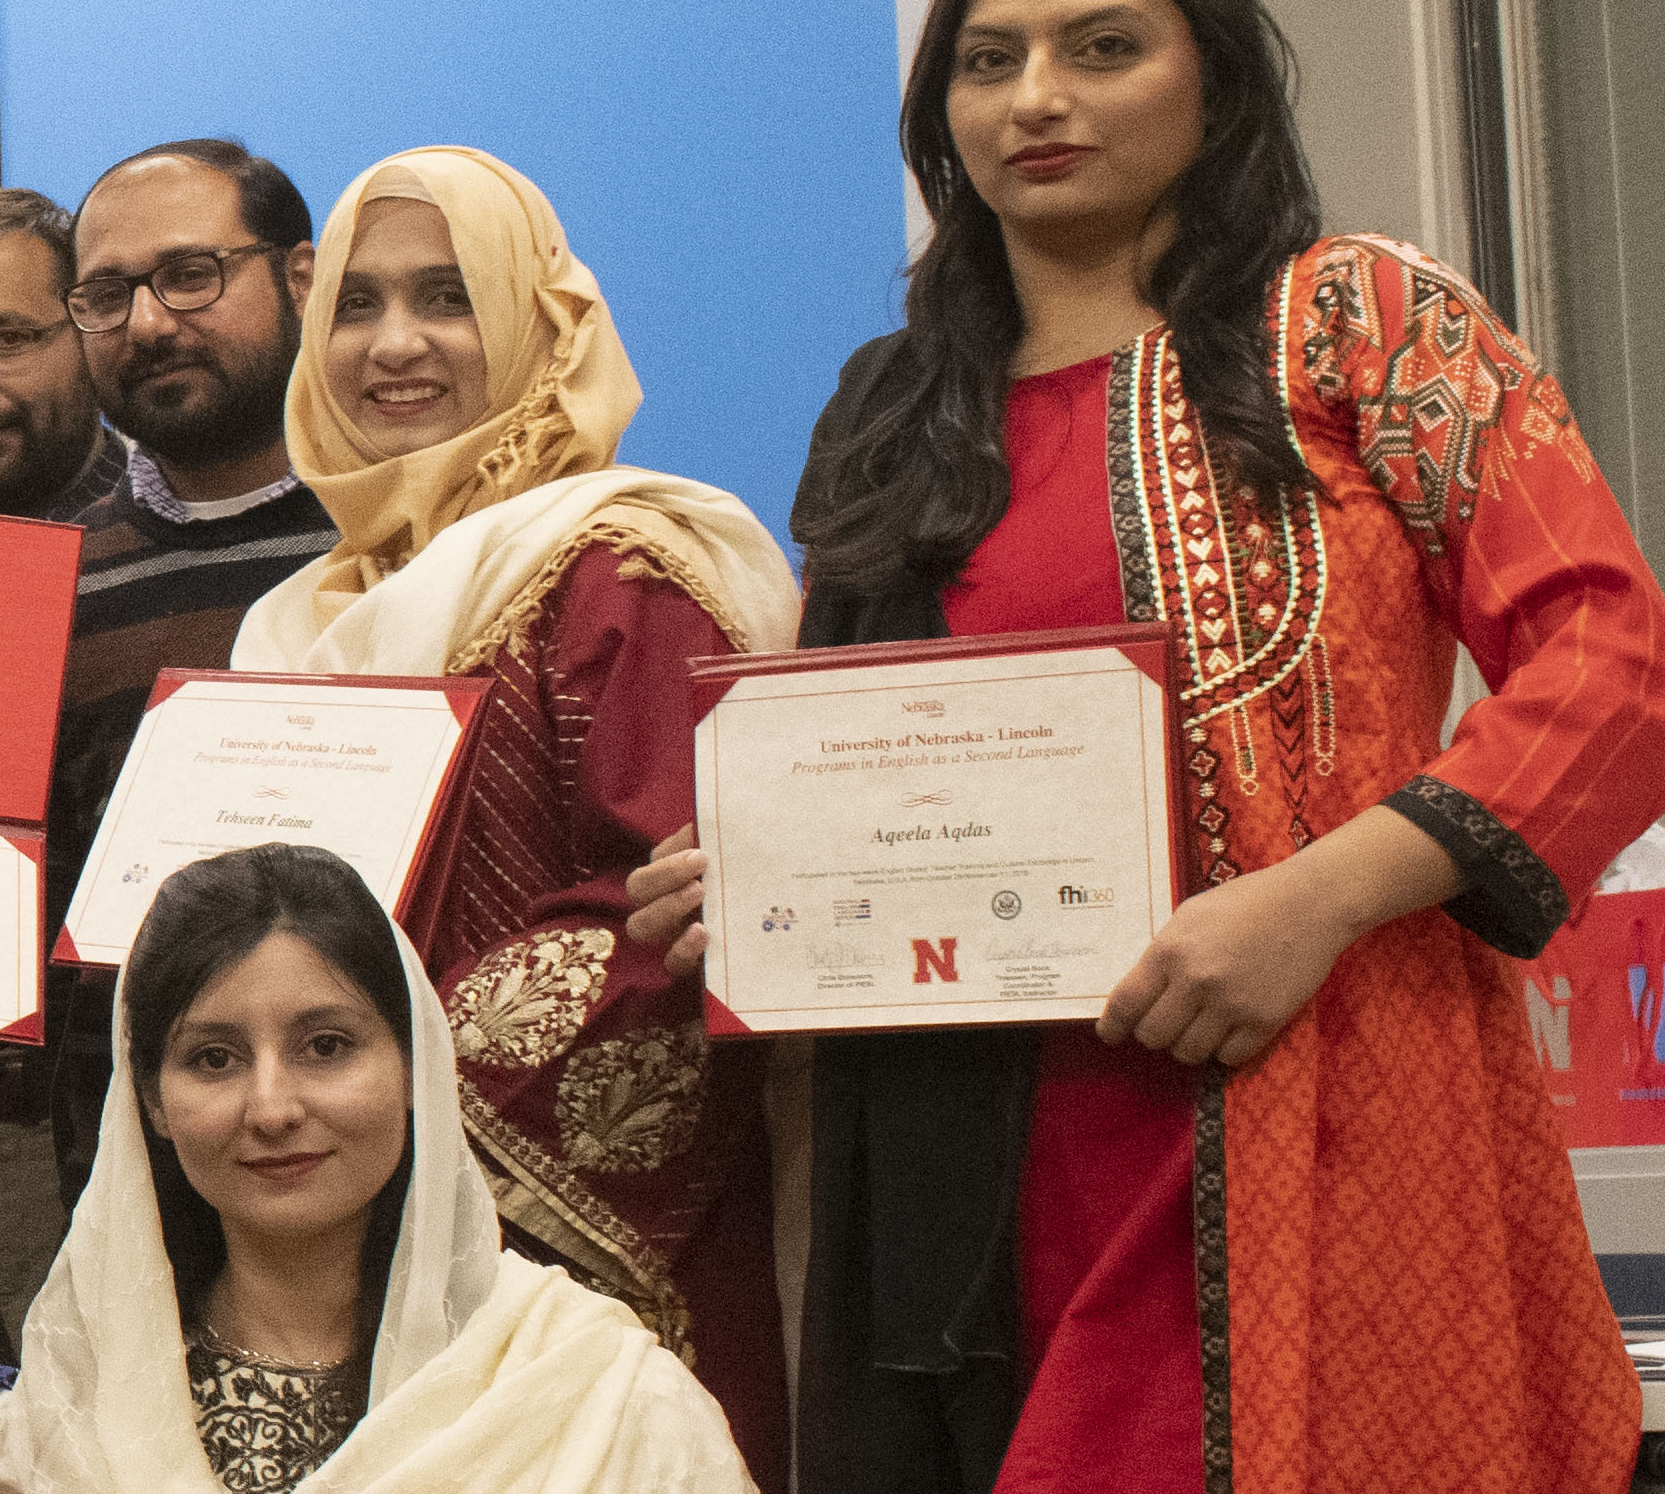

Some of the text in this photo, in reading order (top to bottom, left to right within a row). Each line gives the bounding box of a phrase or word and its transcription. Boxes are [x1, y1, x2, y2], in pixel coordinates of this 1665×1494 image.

[820, 725, 1053, 754] University of Nebraska Lincoln
[870, 822, 993, 846] Aqeela Aqdas
[912, 937, 958, 985] N
